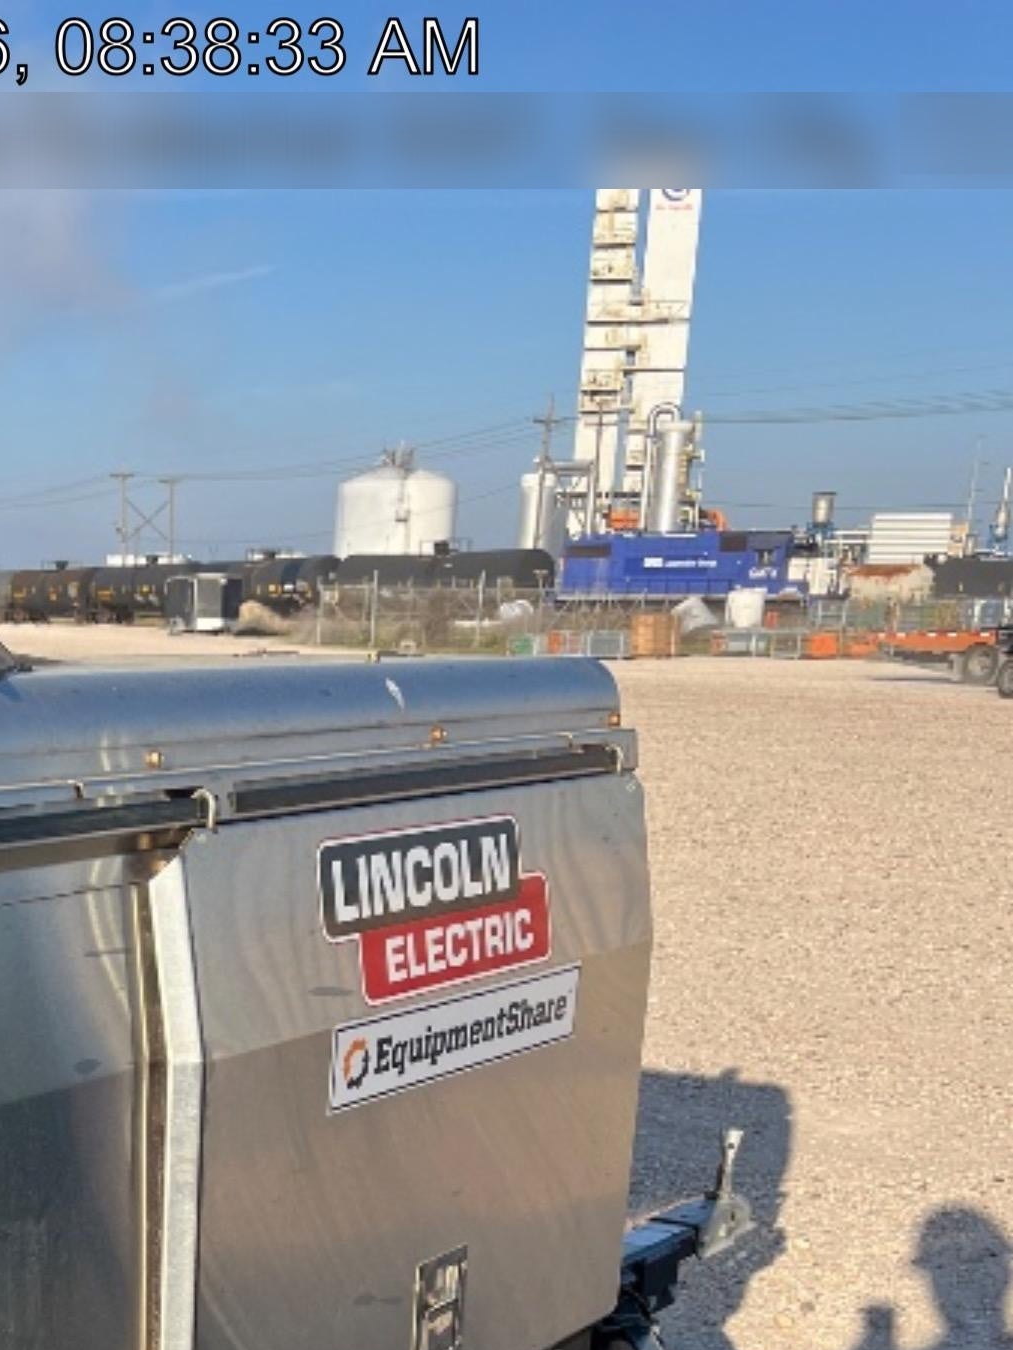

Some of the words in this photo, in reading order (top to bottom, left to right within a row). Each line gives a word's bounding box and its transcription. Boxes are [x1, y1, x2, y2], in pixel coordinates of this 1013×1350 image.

[332, 833, 510, 924] LINCOLN
[385, 908, 535, 984] ELECTRIC
[374, 994, 568, 1077] EquipmentShare
